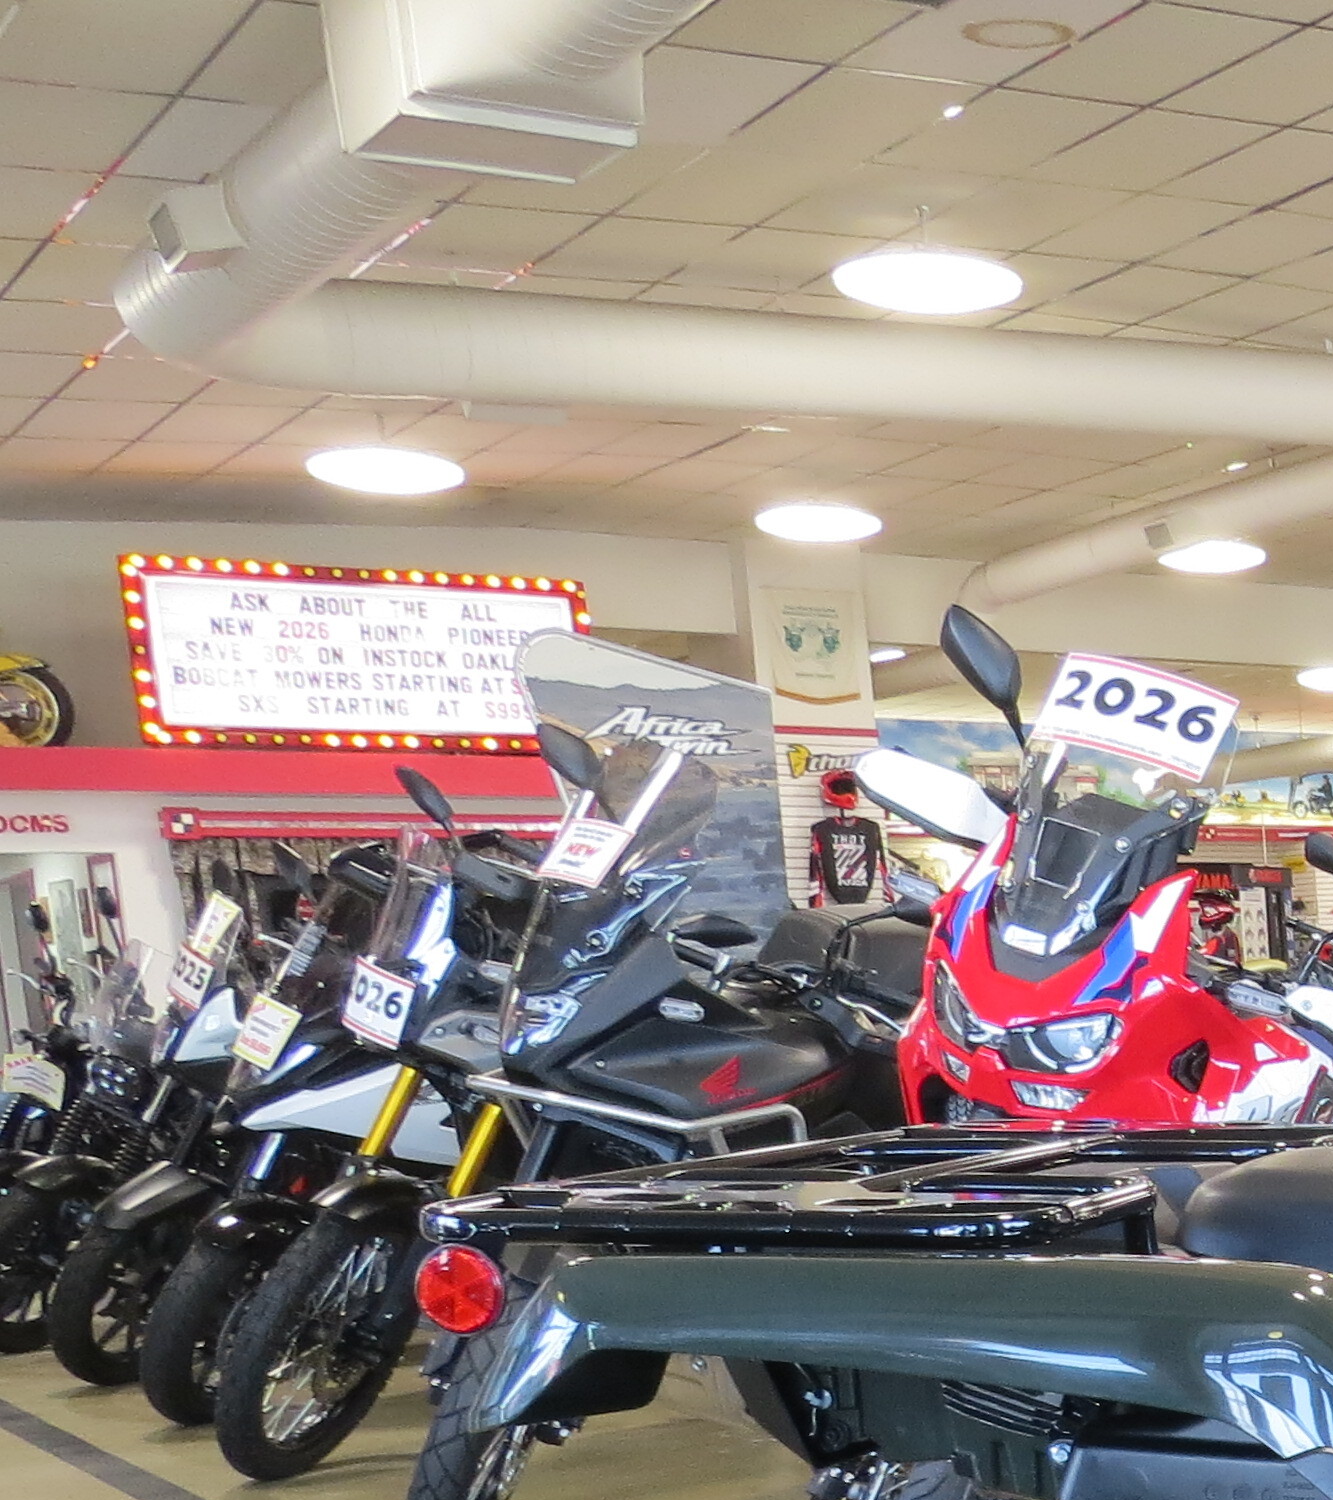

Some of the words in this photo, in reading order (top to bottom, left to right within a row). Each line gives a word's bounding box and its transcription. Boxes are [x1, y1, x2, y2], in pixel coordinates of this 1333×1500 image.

[230, 591, 271, 613] ASK
[299, 595, 367, 617] ABOUT
[388, 599, 428, 620] THE
[460, 603, 498, 623] ALL
[209, 616, 255, 637] NEW
[277, 619, 330, 641] 2026
[359, 623, 427, 643] HONDA
[184, 640, 244, 662] SAVE
[317, 646, 345, 666] ON
[362, 647, 449, 669] INSTOCK
[462, 652, 516, 672] OAKL
[273, 670, 363, 691] MOWERS
[371, 672, 474, 695] STARTING
[480, 676, 505, 694] AT
[237, 694, 281, 714] SXS
[307, 695, 410, 717] STARTING
[436, 699, 461, 718] AT
[1054, 669, 1218, 744] 2026
[582, 705, 752, 741] Africa
[648, 736, 762, 757] Twin
[172, 956, 208, 991] 025
[351, 973, 405, 1020] 026
